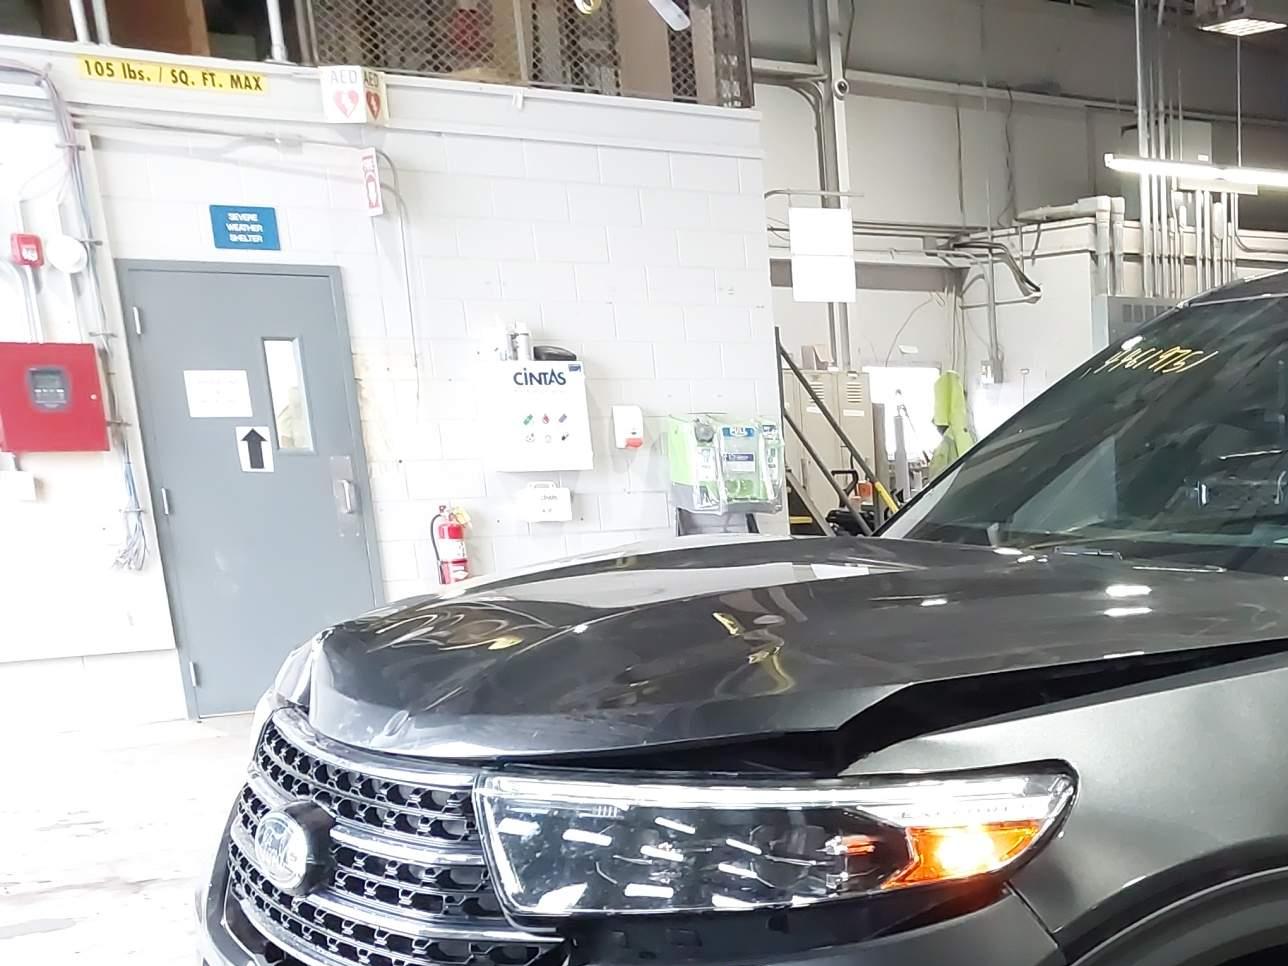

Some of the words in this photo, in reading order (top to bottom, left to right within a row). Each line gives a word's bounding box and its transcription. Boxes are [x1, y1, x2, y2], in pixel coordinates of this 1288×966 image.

[84, 60, 114, 77] 105
[122, 63, 151, 81] lbs.
[171, 69, 195, 86] SQ.
[202, 72, 223, 88] FT.
[230, 74, 263, 91] MAX
[363, 70, 379, 88] AED
[227, 212, 258, 221] SEVERE
[225, 223, 264, 232] WEATHER
[229, 234, 264, 243] SHELTER
